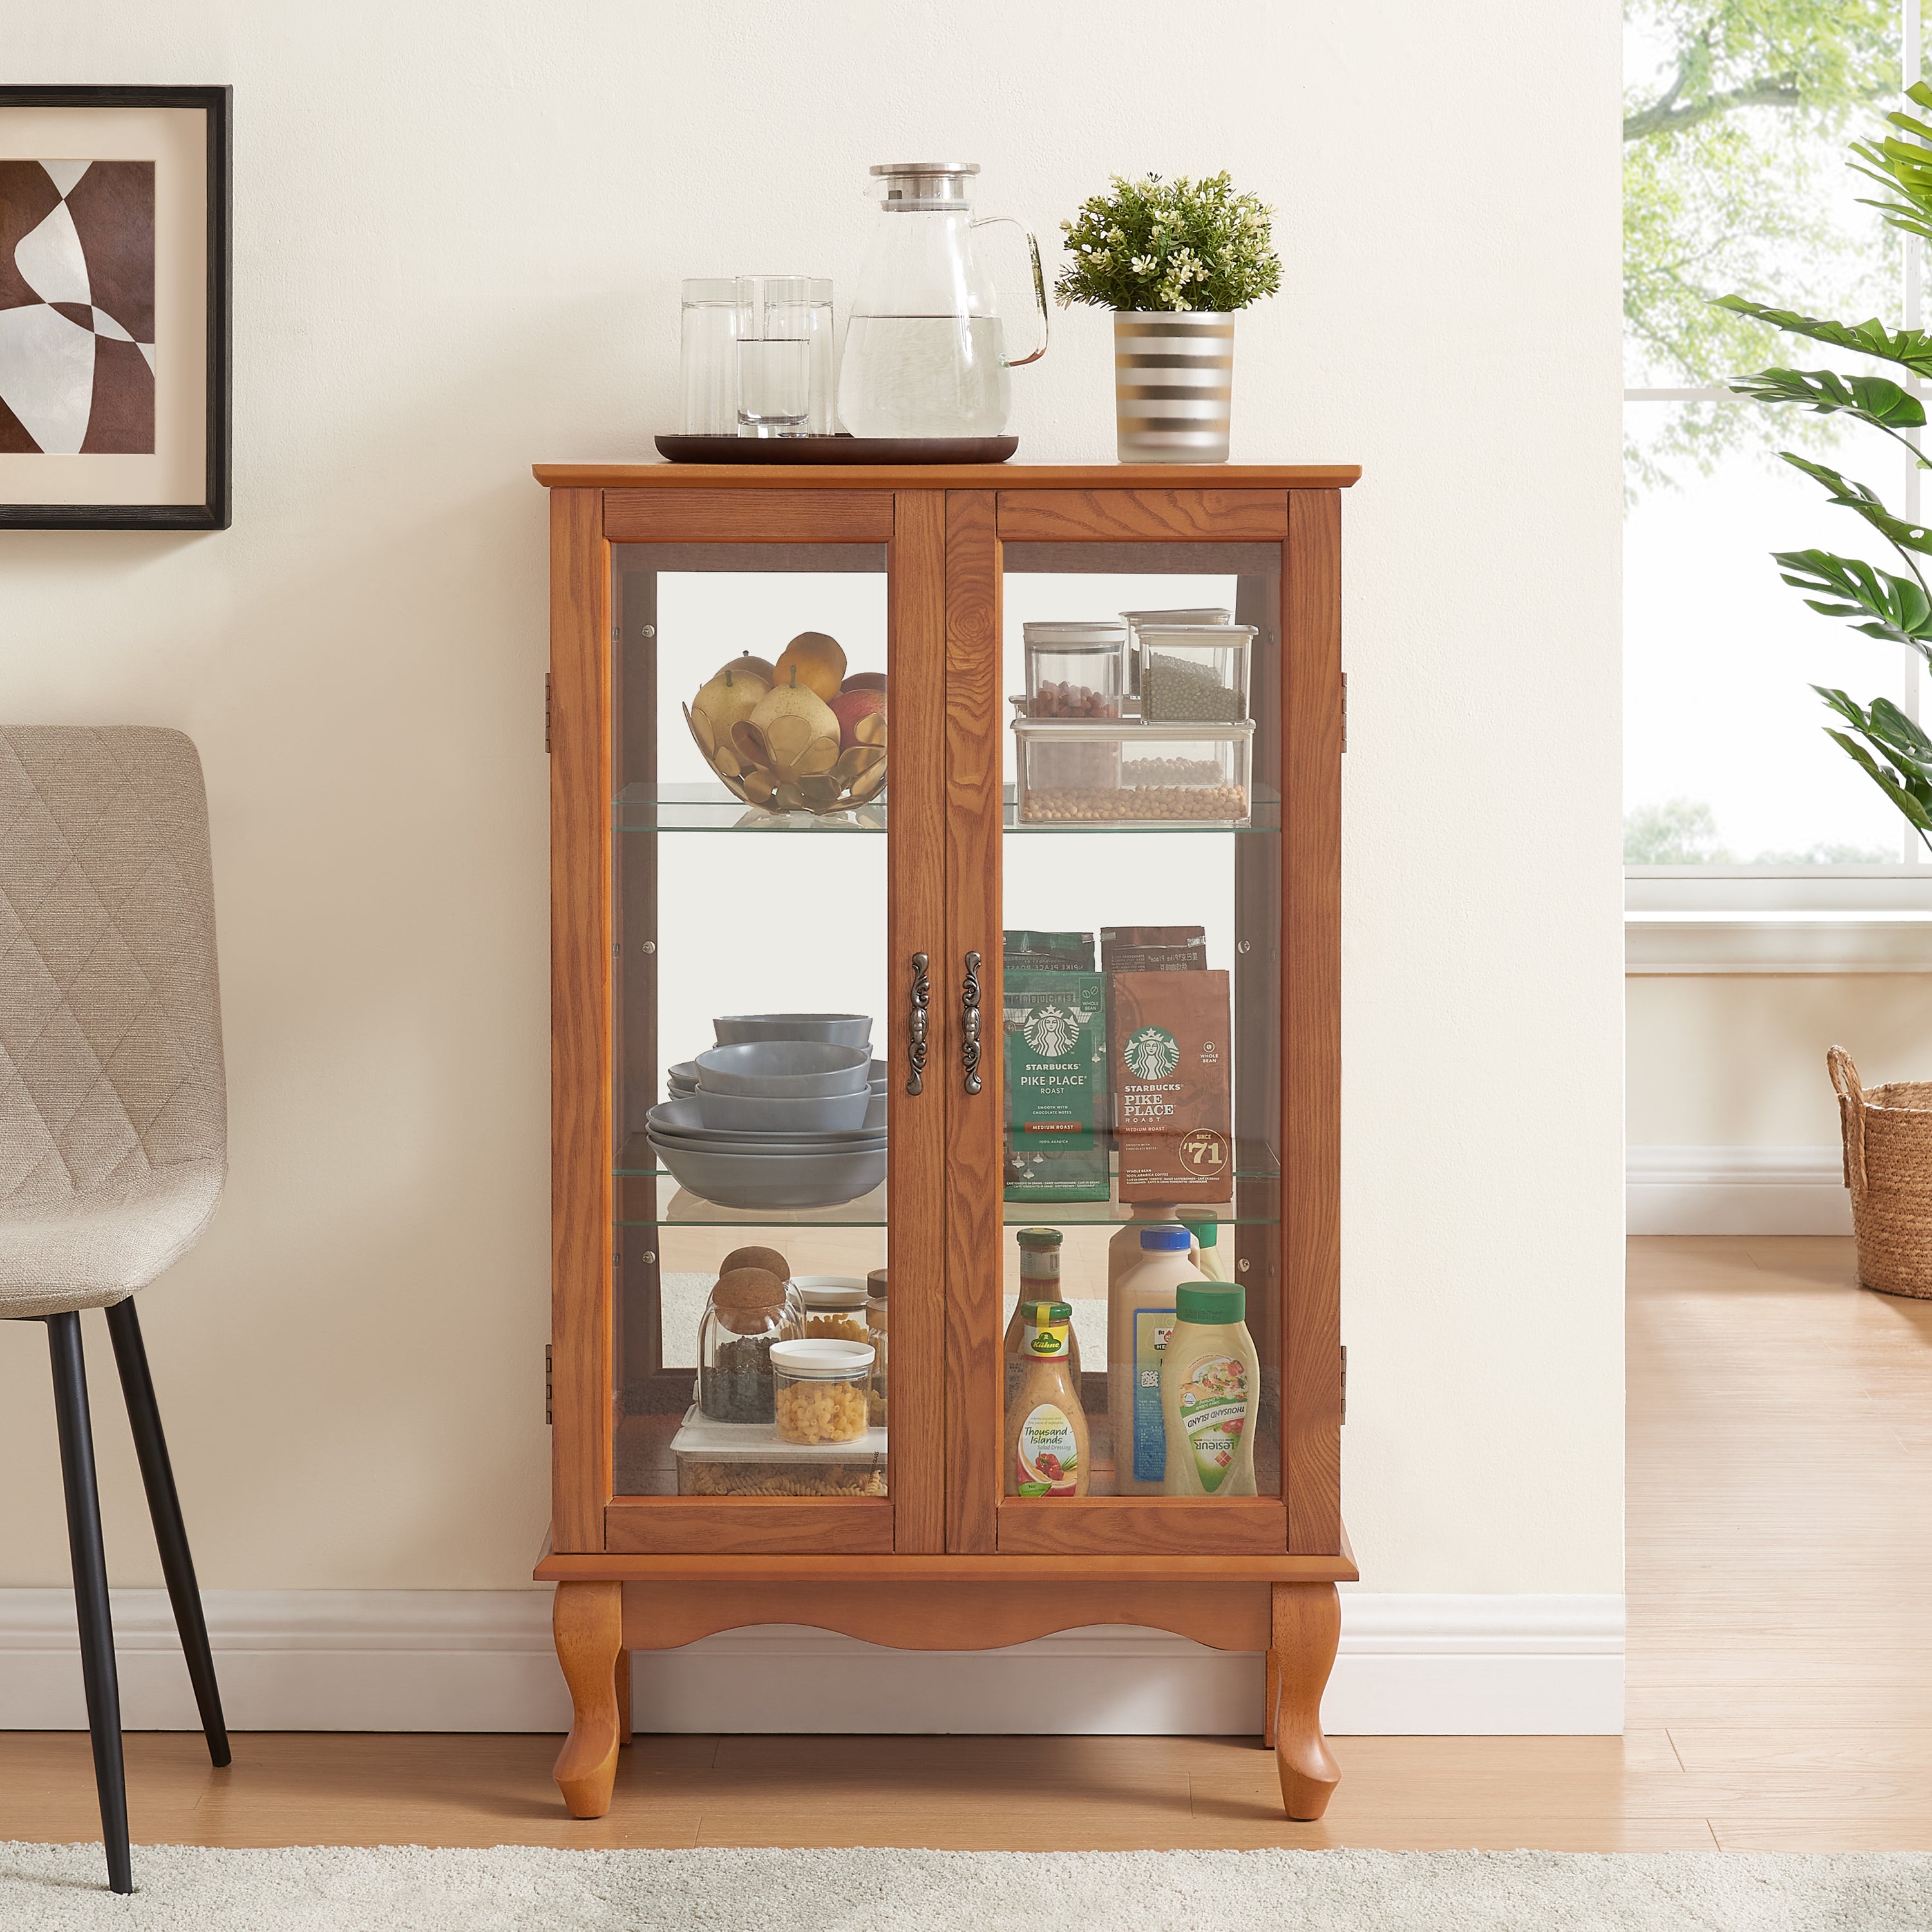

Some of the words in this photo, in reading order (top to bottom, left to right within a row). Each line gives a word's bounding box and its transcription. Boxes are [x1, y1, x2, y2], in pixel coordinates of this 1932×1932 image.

[1021, 1076, 1046, 1085] PIKE
[1049, 1076, 1084, 1085] PLACE
[1124, 1084, 1180, 1092] STARBUCKS
[1124, 1094, 1162, 1105] PIKE
[1124, 1104, 1174, 1115] PLACE
[1211, 1406, 1245, 1418] THOUSAND
[1188, 1414, 1209, 1427] ISLAND
[1025, 1427, 1068, 1435] Thousand
[1030, 1435, 1063, 1444] Islands
